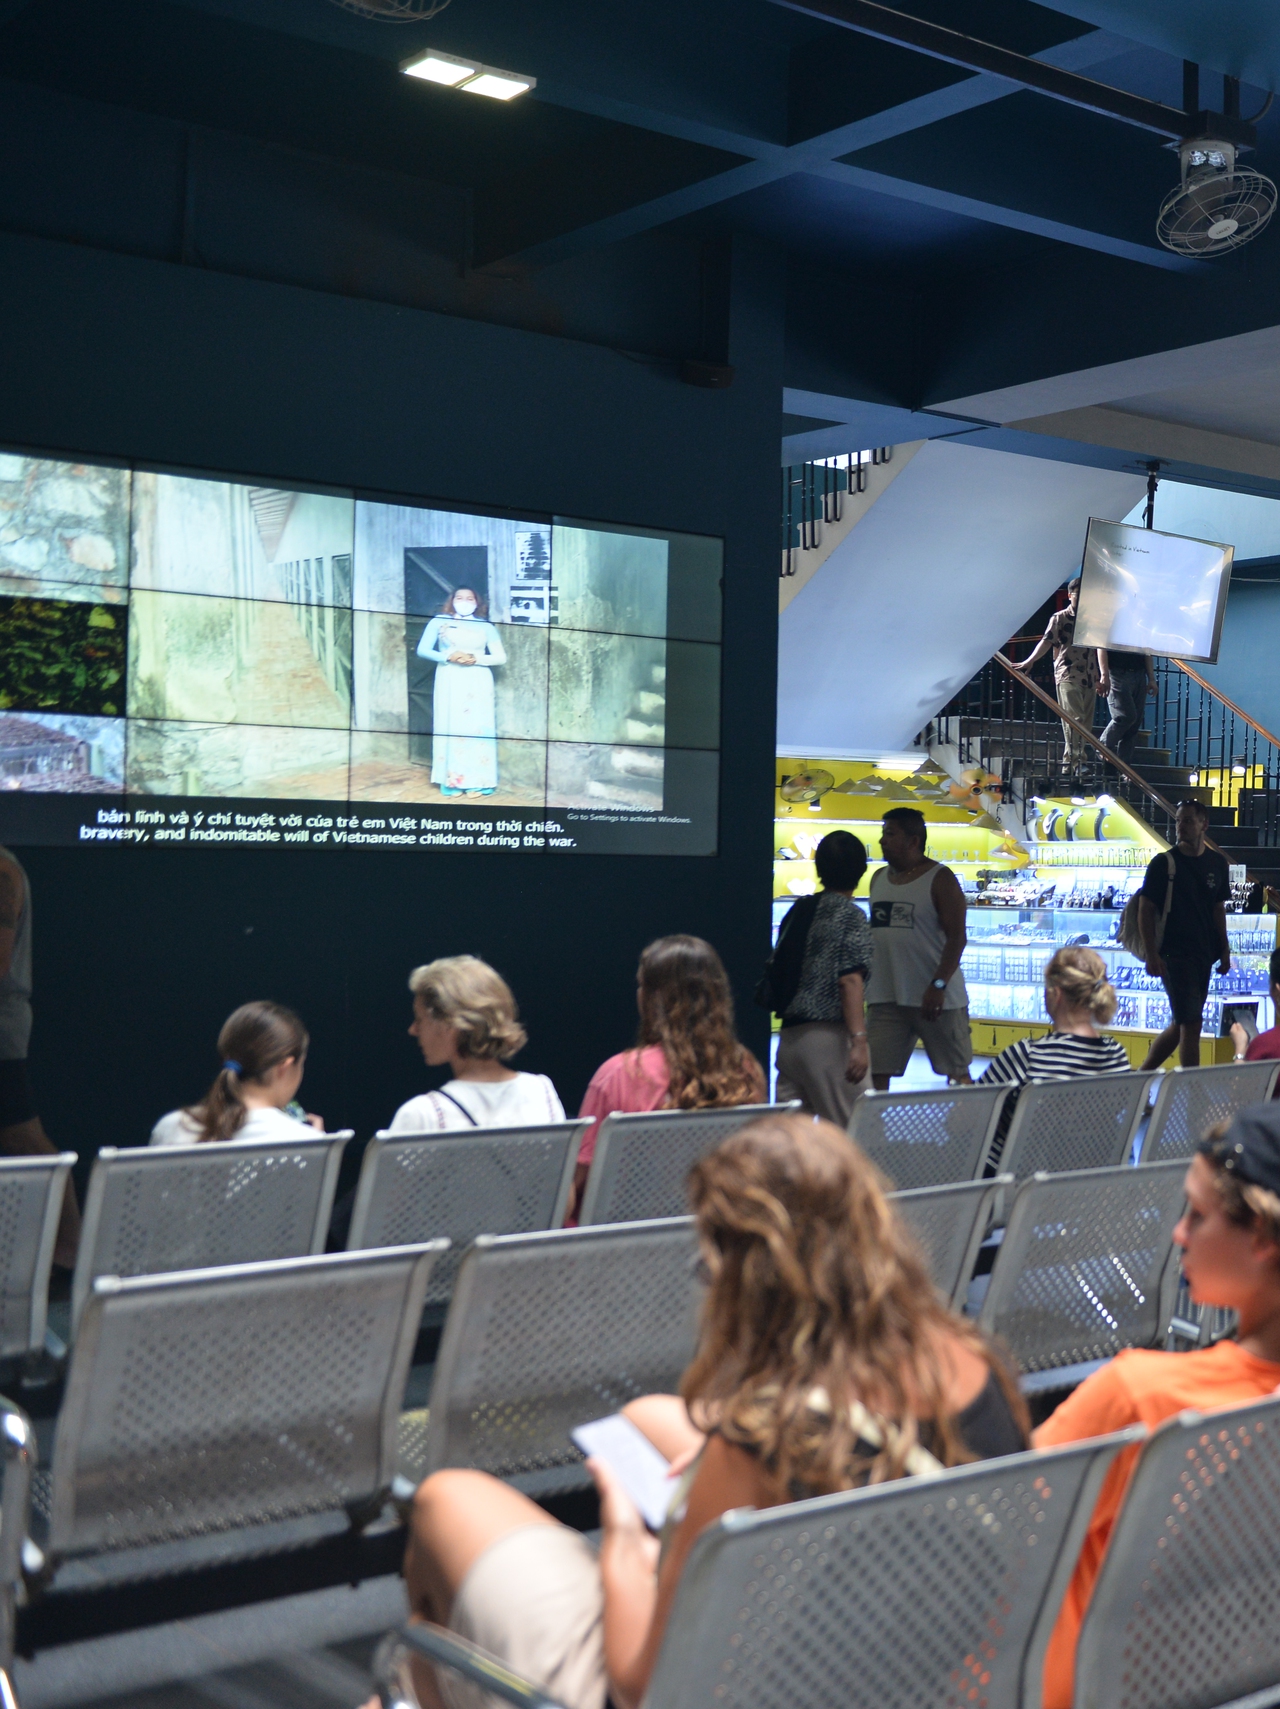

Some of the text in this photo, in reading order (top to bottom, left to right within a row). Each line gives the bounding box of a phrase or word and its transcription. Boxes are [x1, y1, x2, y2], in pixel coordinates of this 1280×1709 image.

[169, 811, 189, 825] và
[193, 812, 204, 827] ý
[207, 812, 232, 826] chí
[235, 813, 276, 830] tuyệt
[362, 818, 386, 829] em
[389, 817, 418, 832] Việt
[420, 818, 453, 831] Nam
[456, 820, 493, 834] trong
[525, 820, 565, 833] chiến.
[567, 813, 579, 821] Go
[590, 813, 619, 823] Settings
[80, 825, 577, 849] bravery, and indomitable will of Vietnamese children during the war.
